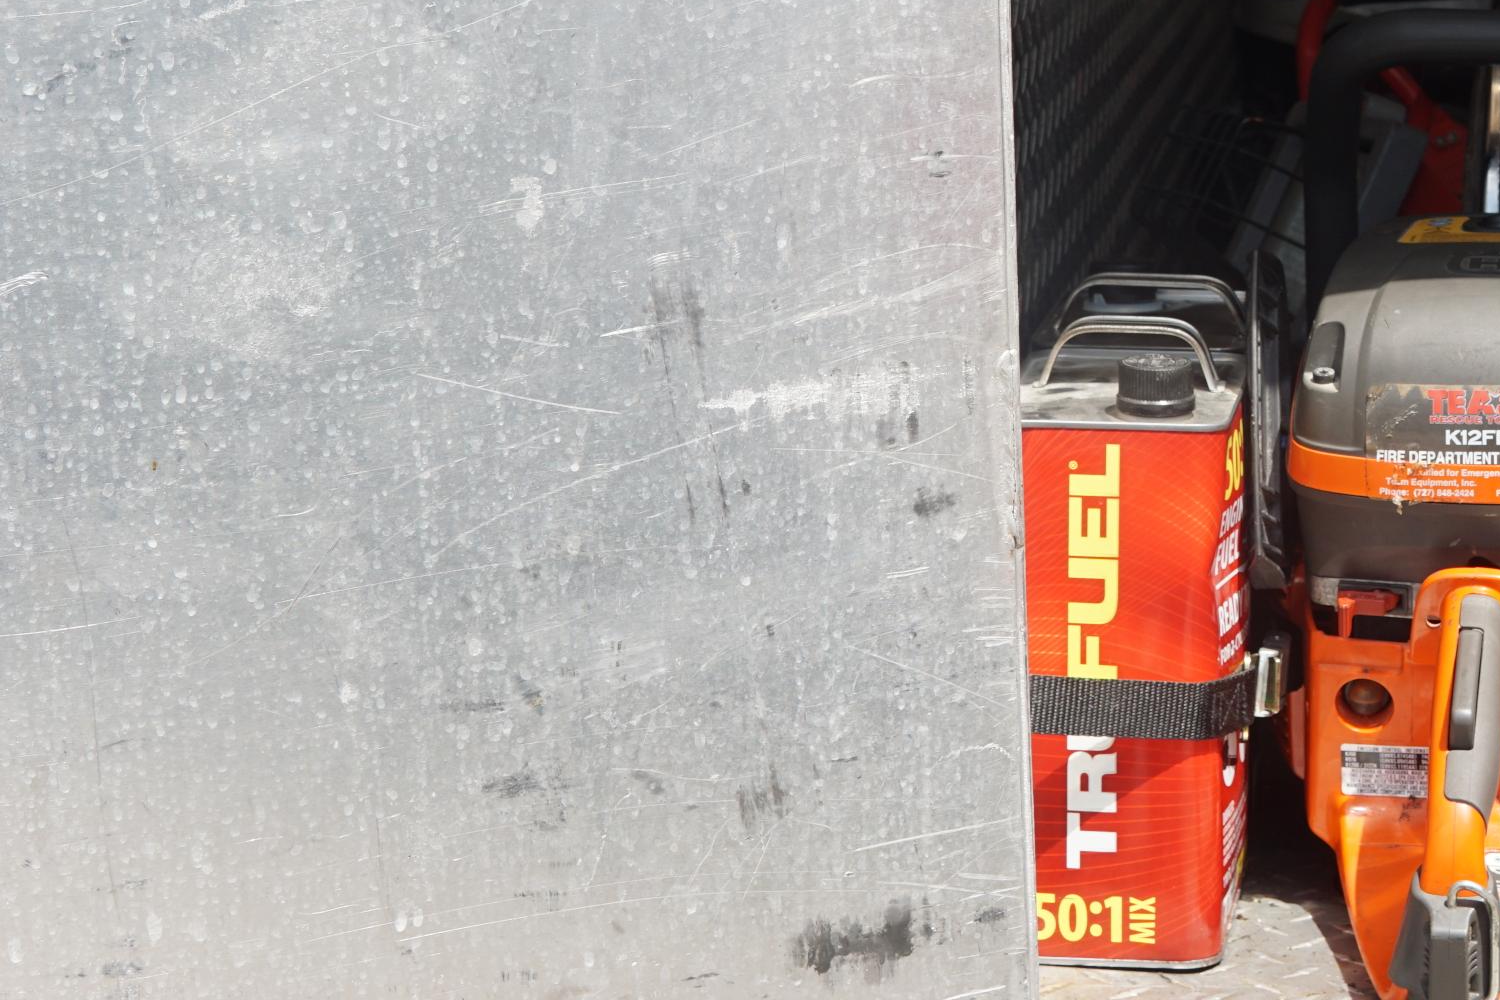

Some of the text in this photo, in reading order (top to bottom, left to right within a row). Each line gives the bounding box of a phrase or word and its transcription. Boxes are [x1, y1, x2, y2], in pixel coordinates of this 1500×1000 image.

[1429, 415, 1483, 425] RESCUE
[1375, 449, 1406, 464] FIRE
[1408, 450, 1500, 466] DEPARTMENT
[1407, 468, 1445, 477] Mified
[1446, 468, 1459, 477] for
[1411, 477, 1460, 488] Equipment,
[1461, 478, 1477, 487] Inc.
[1379, 487, 1410, 497] Phone:
[1413, 488, 1435, 498] (727)
[1214, 528, 1240, 577] FUEL
[1066, 443, 1121, 870] TRFUEL
[1036, 892, 1157, 946] 50:1 MIX
